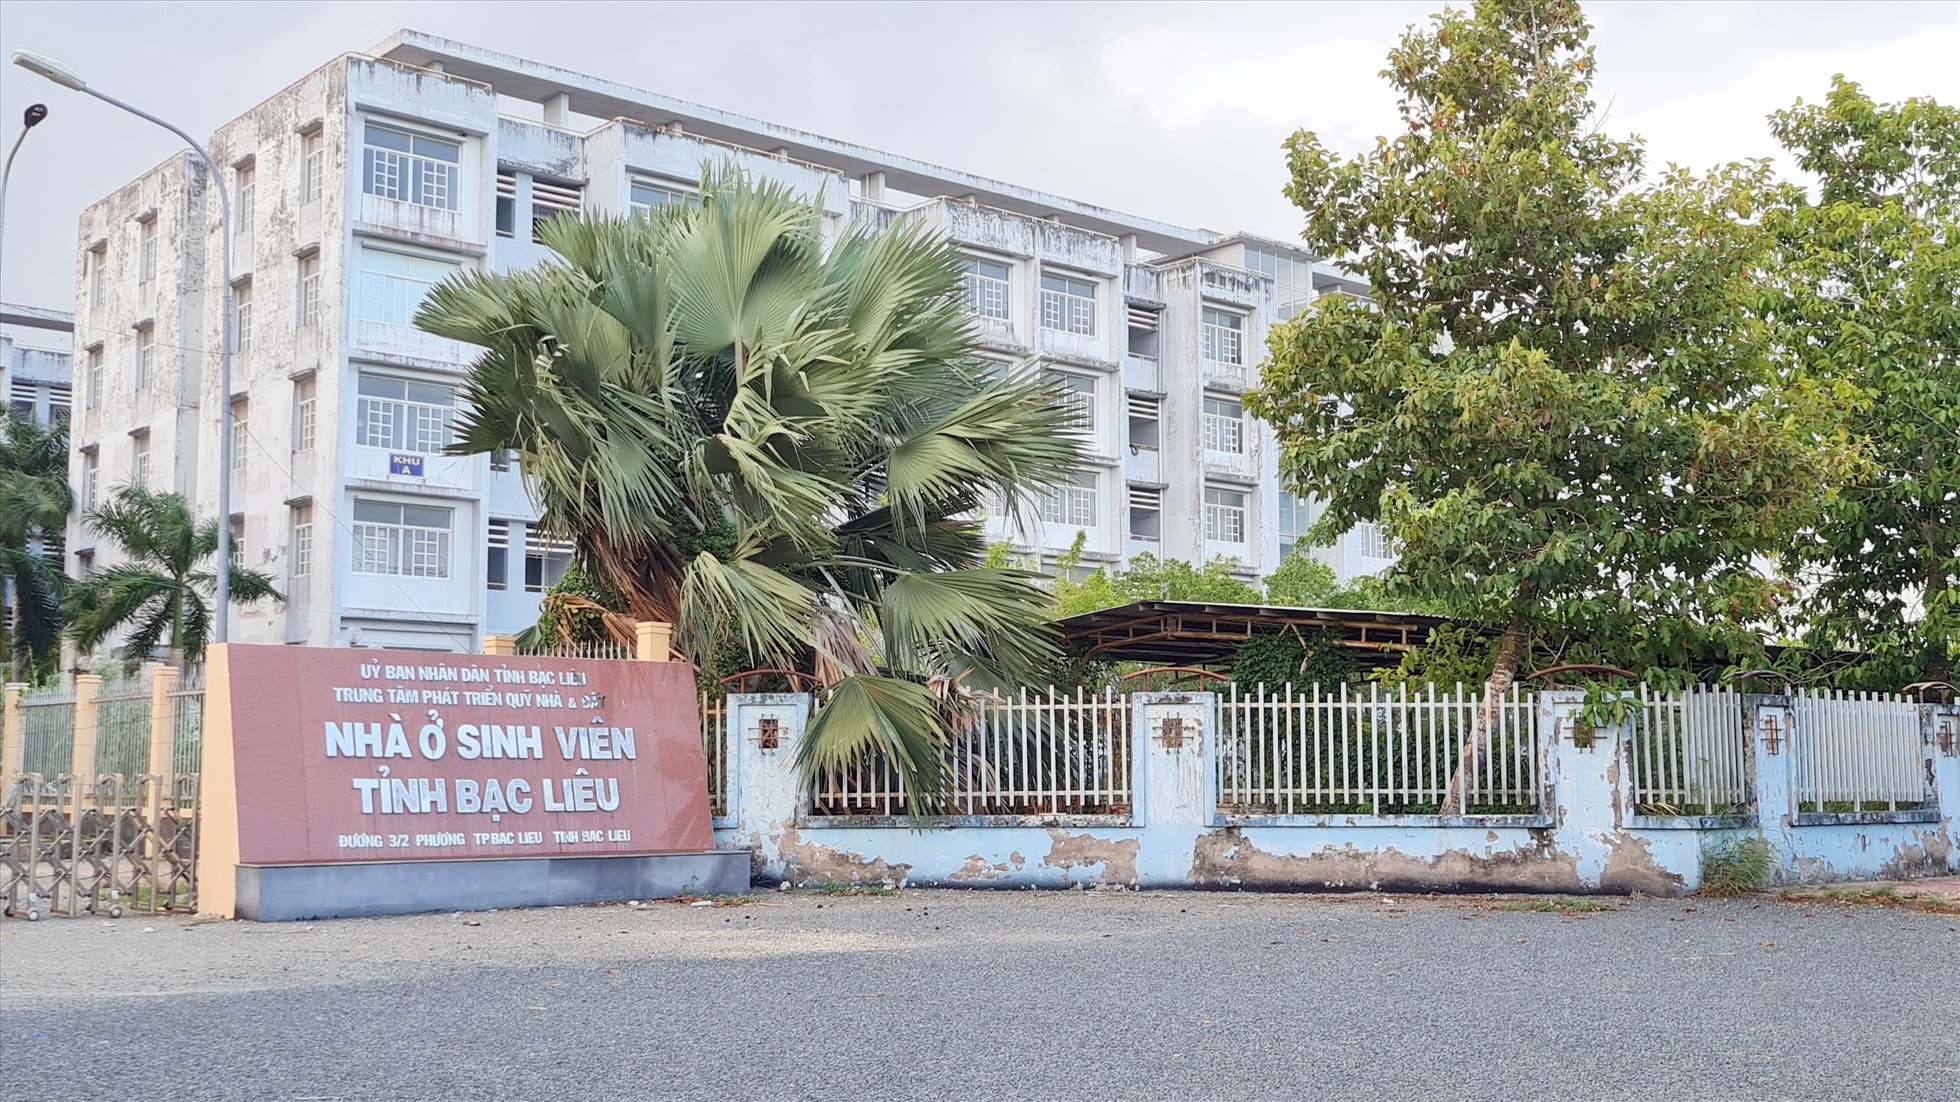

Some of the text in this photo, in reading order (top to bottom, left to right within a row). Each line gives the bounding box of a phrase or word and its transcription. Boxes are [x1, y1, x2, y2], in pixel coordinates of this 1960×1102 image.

[393, 455, 420, 466] KHU
[402, 465, 411, 475] A
[361, 658, 381, 679] UỶ
[385, 665, 415, 680] BAN
[418, 662, 458, 682] NHÂN
[461, 664, 489, 683] DÂN
[494, 664, 526, 684] TỈNH
[529, 671, 555, 689] BẠC
[333, 687, 384, 703] TRUNG
[386, 685, 419, 704] TÂM
[422, 686, 460, 705] PHÁT
[463, 685, 503, 706] TRIỂN
[535, 690, 563, 708] NHÀ
[568, 697, 577, 709] &
[325, 708, 637, 760] NHÀ Ở SINH VIÊN
[352, 765, 621, 822] TỈNH BẠC LIÊU
[388, 834, 410, 848] 3/2
